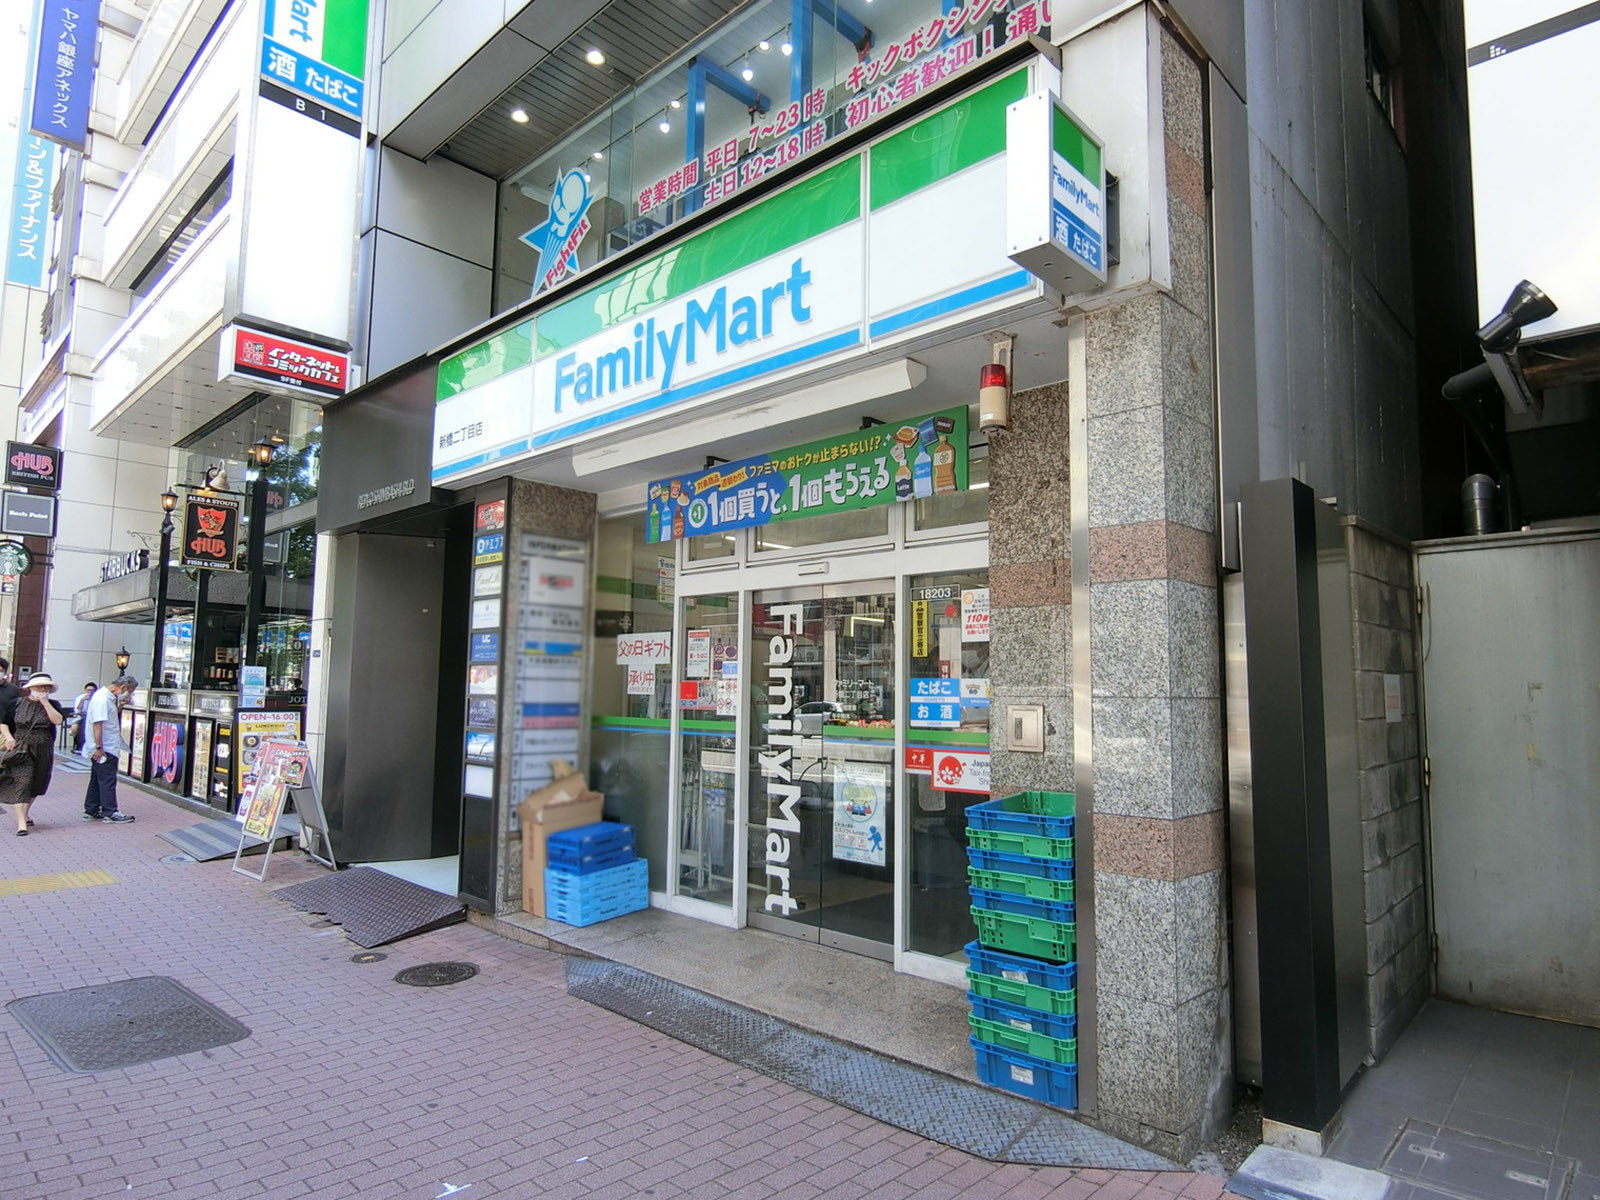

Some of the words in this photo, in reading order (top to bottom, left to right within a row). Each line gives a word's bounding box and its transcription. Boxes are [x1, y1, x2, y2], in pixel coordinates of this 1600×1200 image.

[289, 0, 317, 42] art
[51, 7, 79, 128] ヤマハ銀座アネックス
[268, 46, 298, 82] 酒
[305, 67, 358, 107] たばこ
[705, 138, 738, 175] 平日
[639, 159, 698, 213] 営業時間
[704, 171, 737, 206] 土日
[1053, 165, 1100, 216] FamilyMart
[546, 219, 588, 287] FightFit
[1055, 215, 1069, 247] 酒
[1073, 231, 1097, 265] たばこ
[555, 257, 812, 412] FamilyMart
[266, 356, 340, 383] コミックカフェ
[11, 452, 54, 475] HUB
[100, 549, 141, 582] STARBUCKS
[190, 537, 227, 558] HUB
[920, 588, 951, 599] 18203
[618, 639, 670, 658] 父の日ギフト
[629, 670, 655, 686] 承り中
[917, 681, 952, 695] たばこ
[757, 603, 804, 916] FamilyMart
